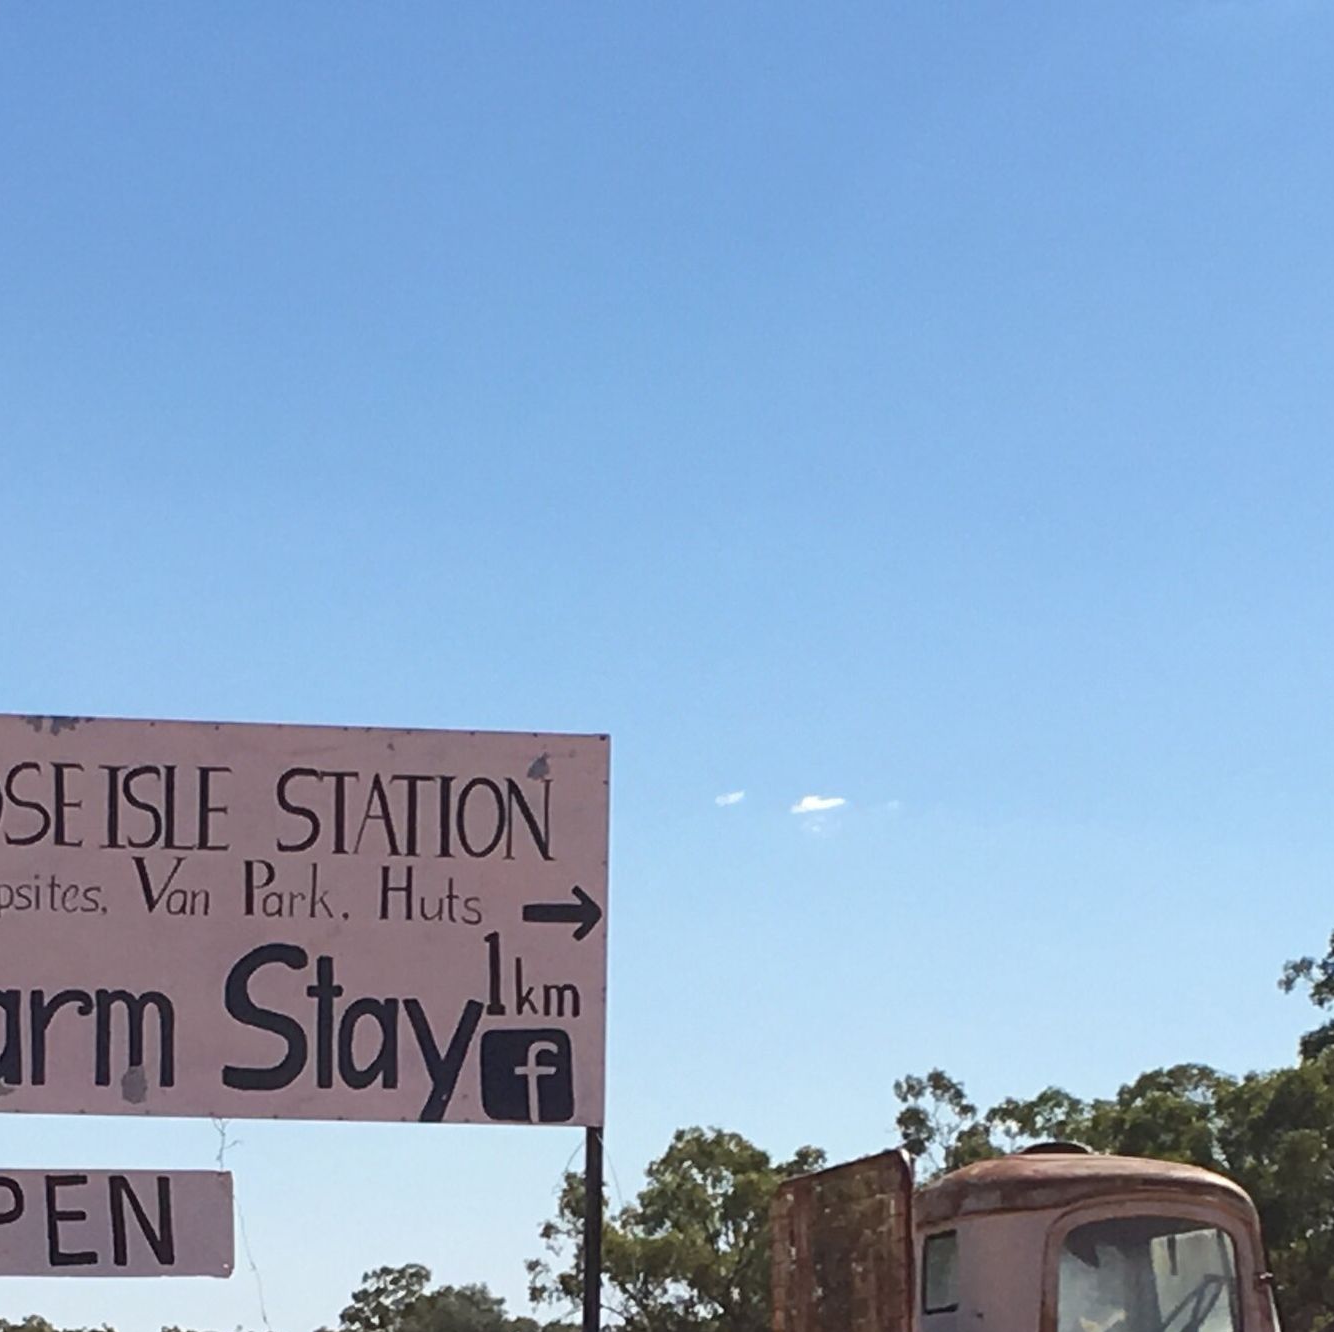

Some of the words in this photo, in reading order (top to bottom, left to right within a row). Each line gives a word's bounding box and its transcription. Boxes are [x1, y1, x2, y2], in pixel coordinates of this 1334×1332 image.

[275, 766, 557, 861] STATION
[131, 855, 211, 916] Van
[378, 864, 483, 926] Huts
[222, 943, 485, 1123] Stay
